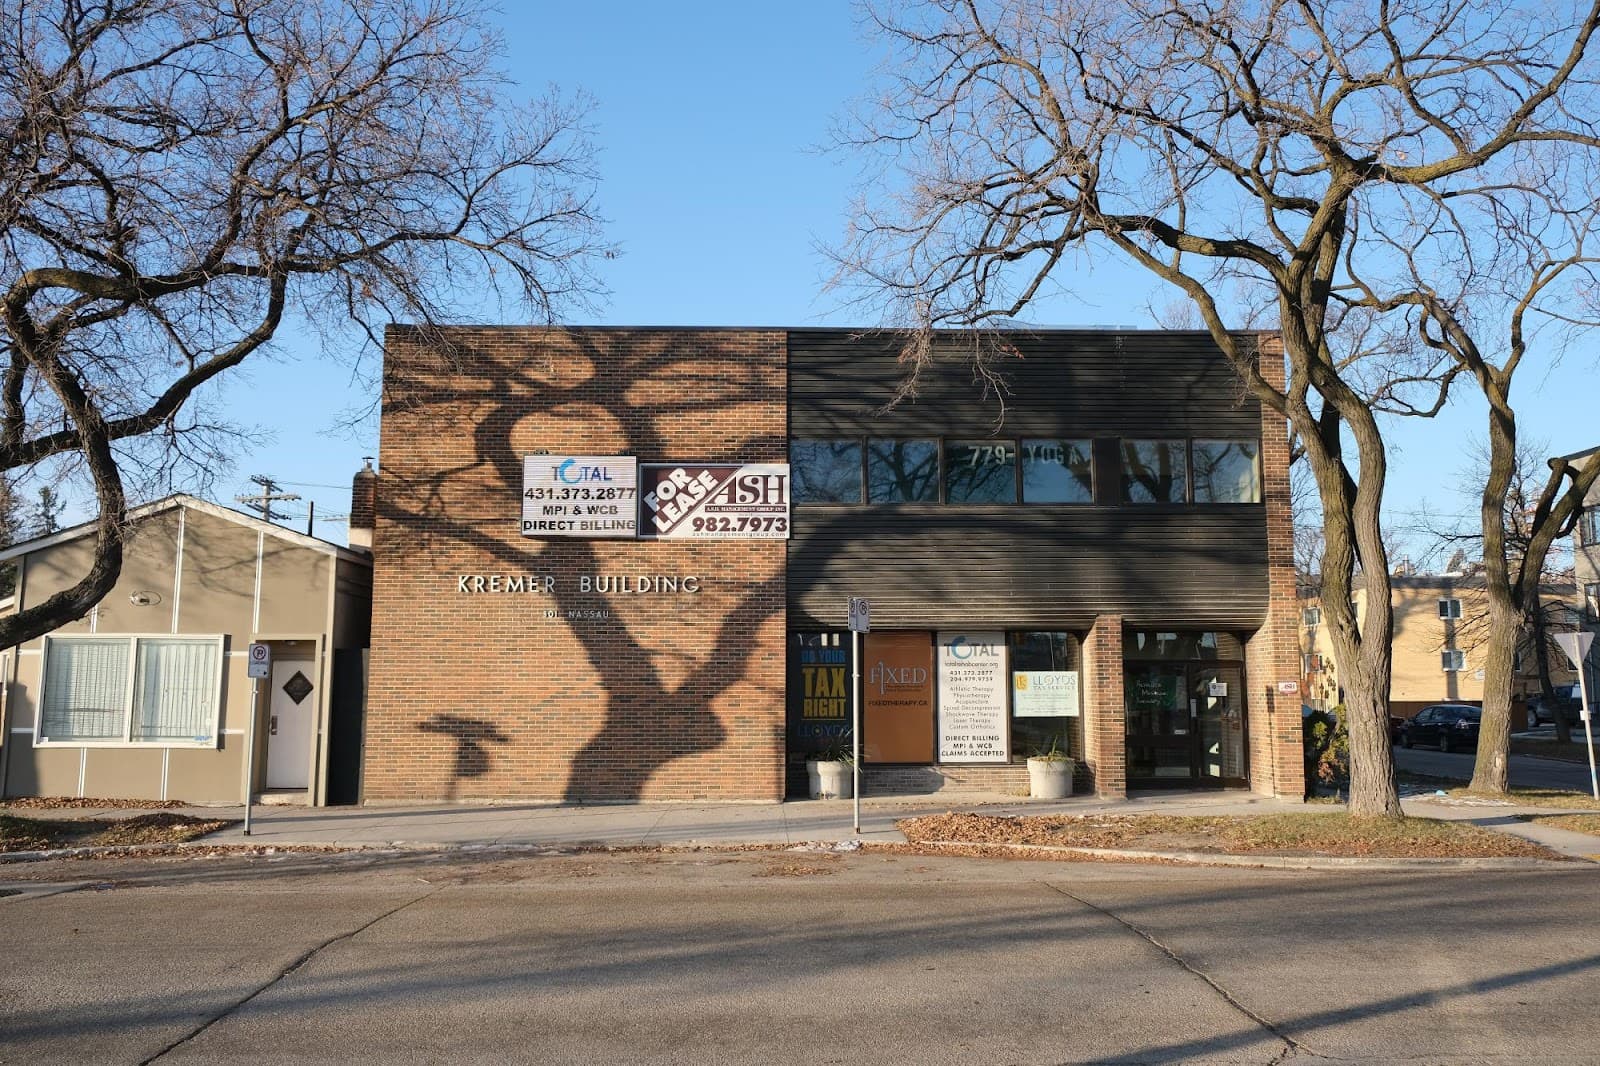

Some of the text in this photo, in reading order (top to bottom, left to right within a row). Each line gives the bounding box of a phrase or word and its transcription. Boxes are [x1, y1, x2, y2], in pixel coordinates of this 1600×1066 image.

[552, 459, 612, 484] TOTAL
[524, 487, 636, 500] 431.373.2877
[643, 467, 694, 513] FOR
[704, 475, 787, 505] ASH
[650, 469, 719, 533] LEASE
[542, 505, 619, 516] MPI & WCB
[523, 520, 636, 531] DIRECT BILLING
[692, 516, 787, 532] 982.7973
[458, 575, 700, 593] KREMER BUILDING
[568, 610, 608, 618] NASSAU
[944, 635, 999, 660] TOTAL
[802, 667, 846, 697] TAX
[1032, 675, 1076, 686] LLOYDS
[804, 699, 846, 717] RIGHT
